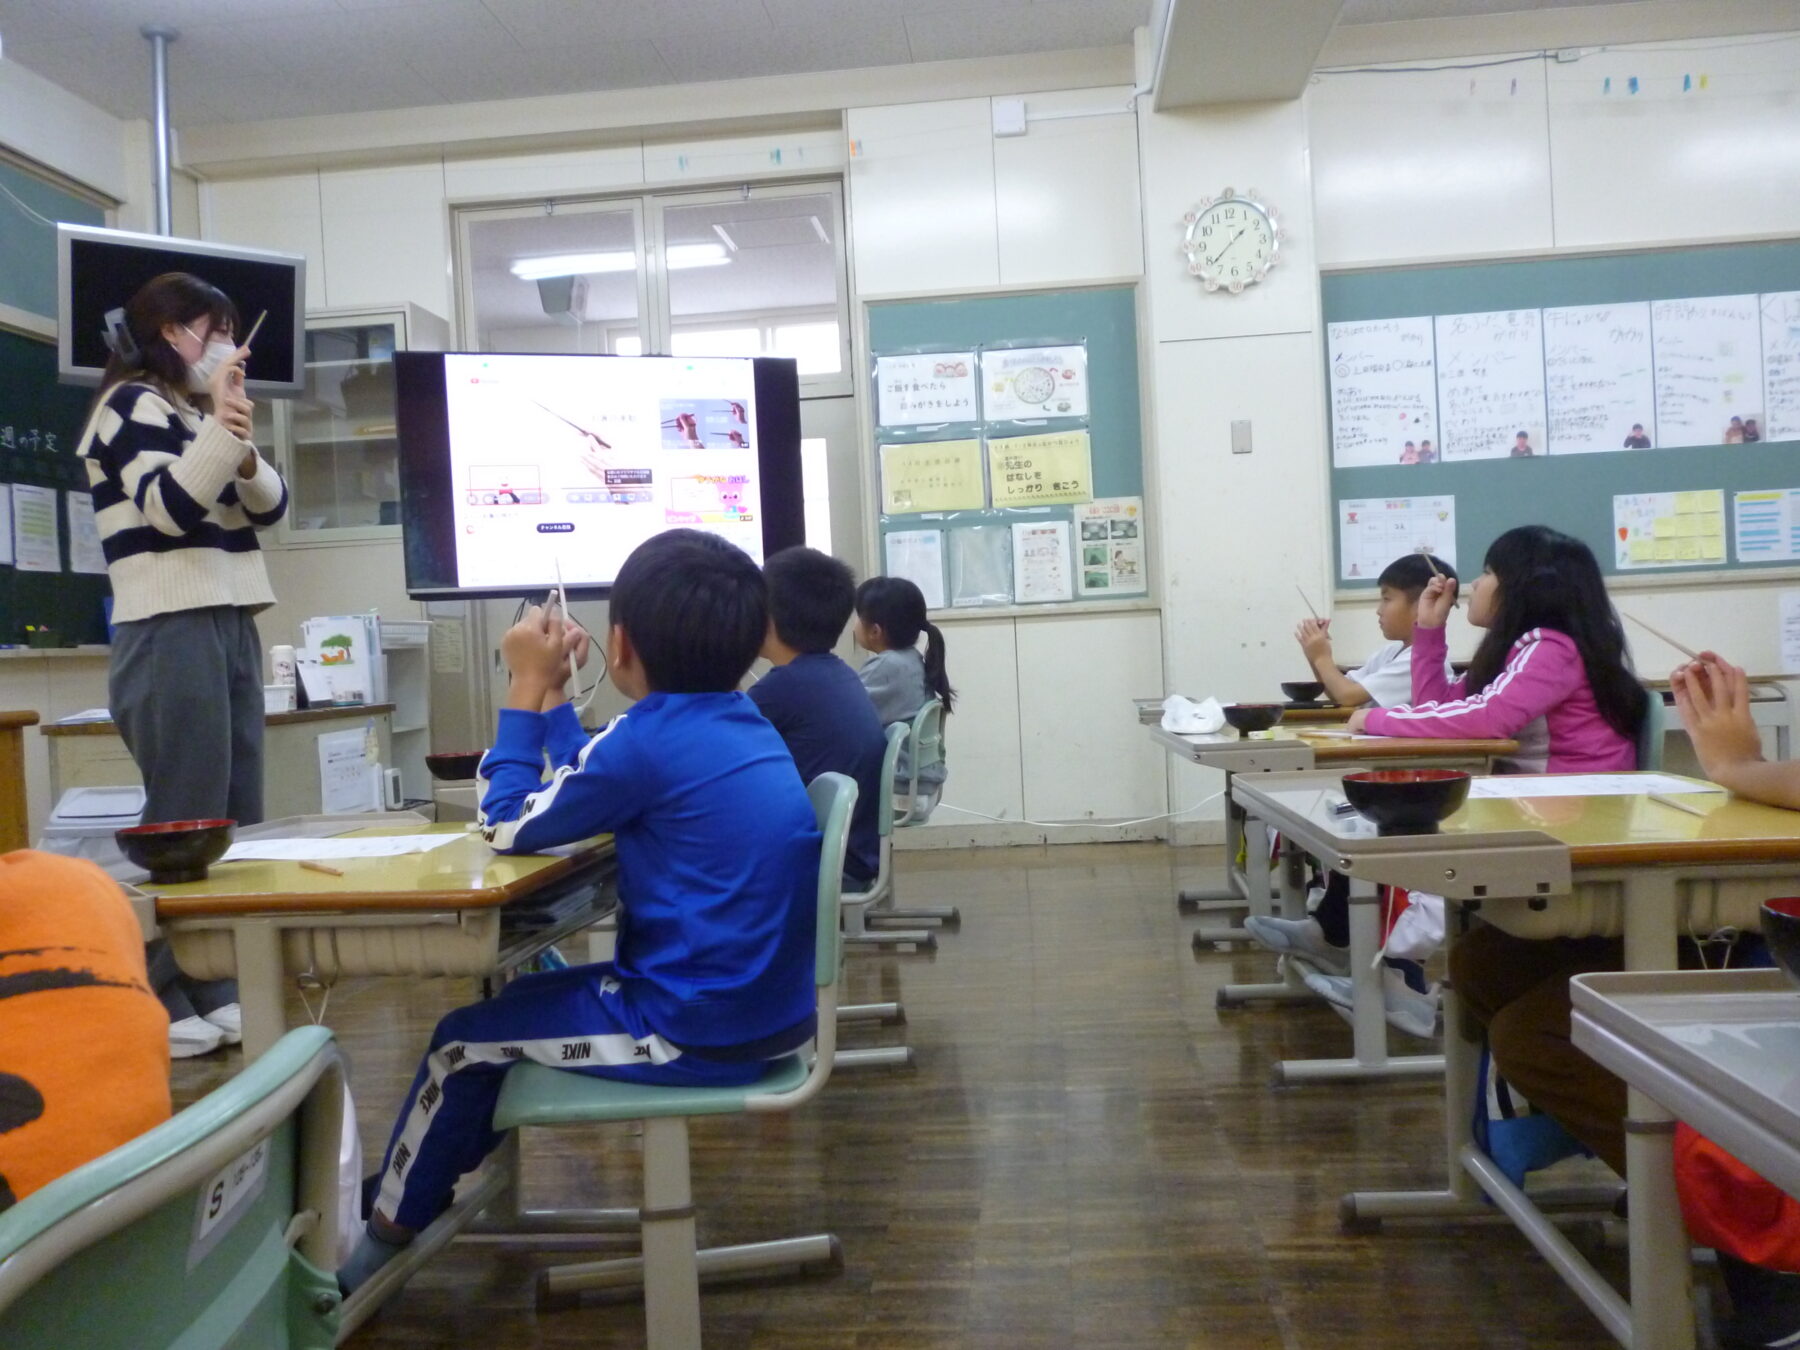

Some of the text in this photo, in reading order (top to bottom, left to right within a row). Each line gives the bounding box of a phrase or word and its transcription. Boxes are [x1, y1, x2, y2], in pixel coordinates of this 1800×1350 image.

[1211, 213, 1220, 225] 11
[1224, 207, 1235, 219] 12
[1243, 209, 1248, 221] 1
[1252, 218, 1261, 231] 2
[1201, 225, 1213, 237] 10
[1258, 233, 1267, 245] 3
[1198, 241, 1207, 252] 9
[1255, 248, 1262, 259] 4
[1205, 256, 1214, 266] 8
[1246, 261, 1253, 272] 5
[1216, 264, 1224, 275] 7
[1230, 266, 1239, 277] 6
[1, 426, 59, 453] 週の予定
[1006, 472, 1042, 482] はなしを
[562, 1042, 591, 1060] NIKE
